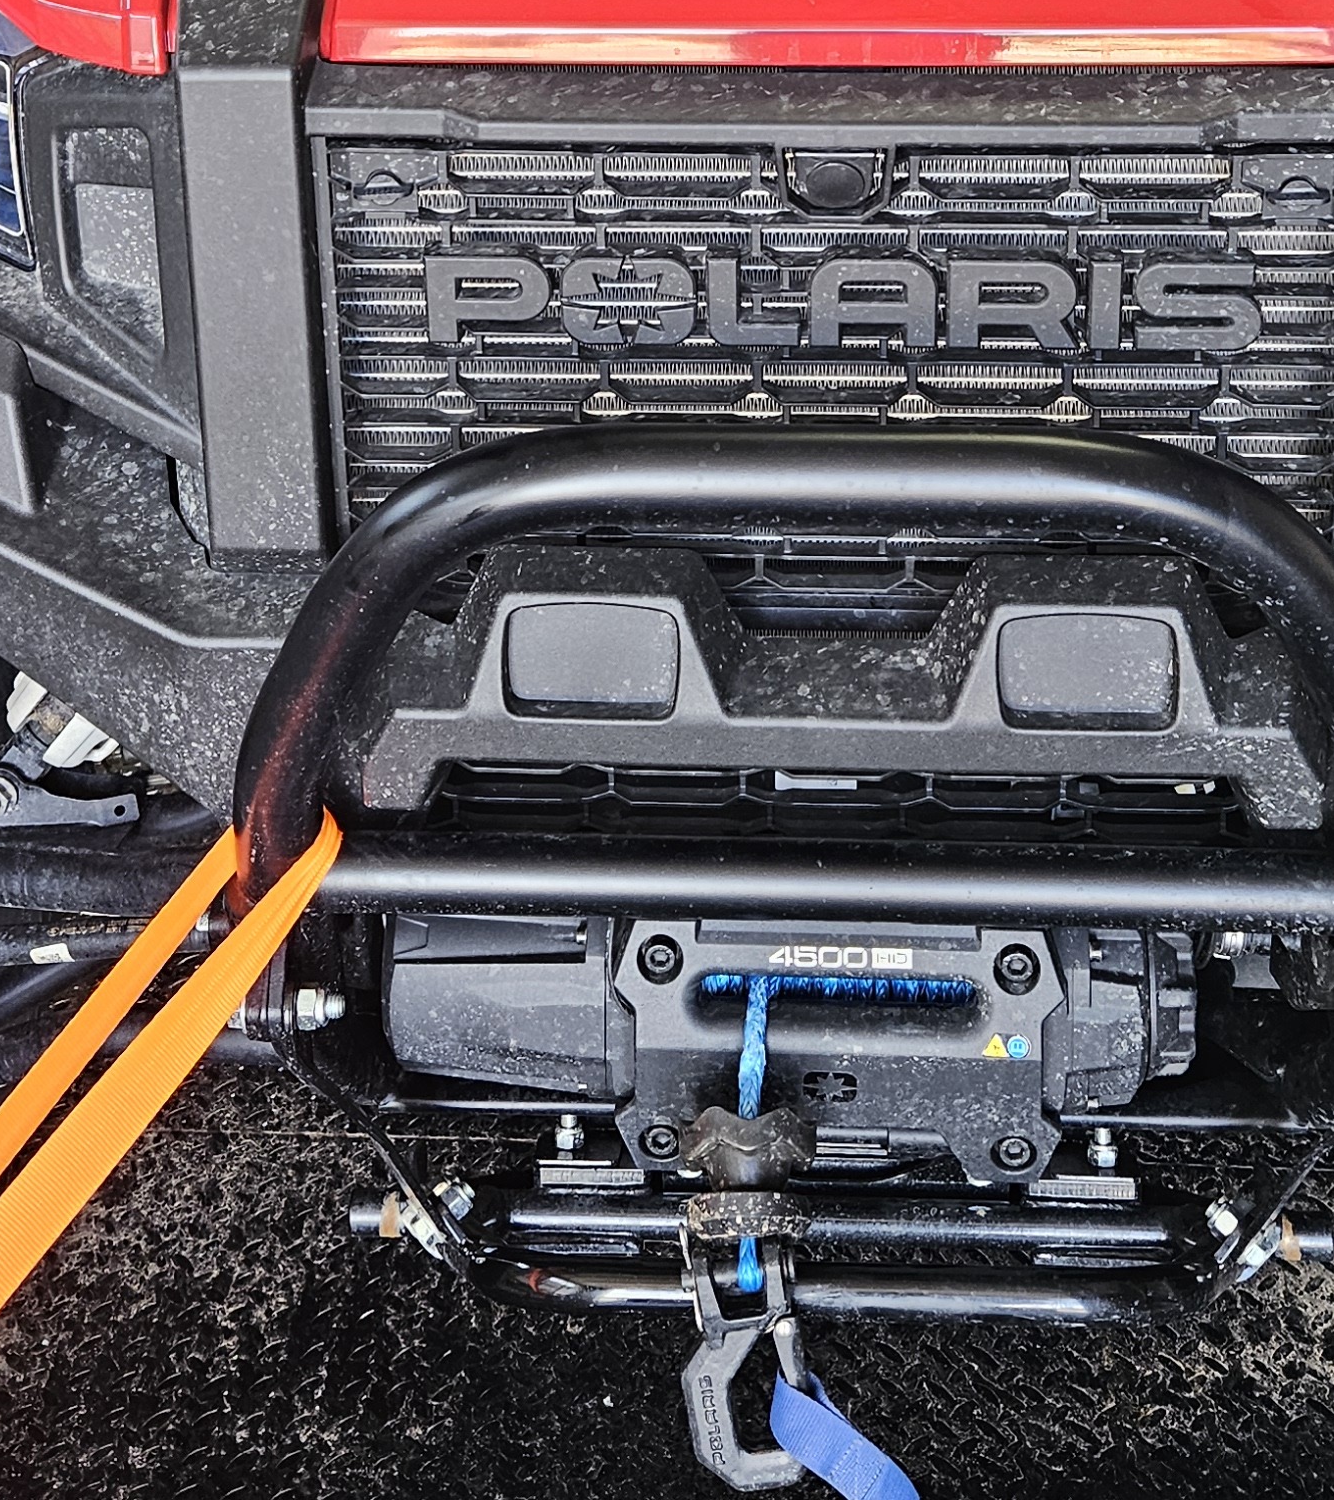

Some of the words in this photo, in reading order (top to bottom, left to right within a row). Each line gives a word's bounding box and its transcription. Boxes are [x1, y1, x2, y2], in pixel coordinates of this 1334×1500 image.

[424, 248, 1264, 353] POLARIS
[768, 946, 869, 969] 4500
[699, 1375, 726, 1466] POLARIS
